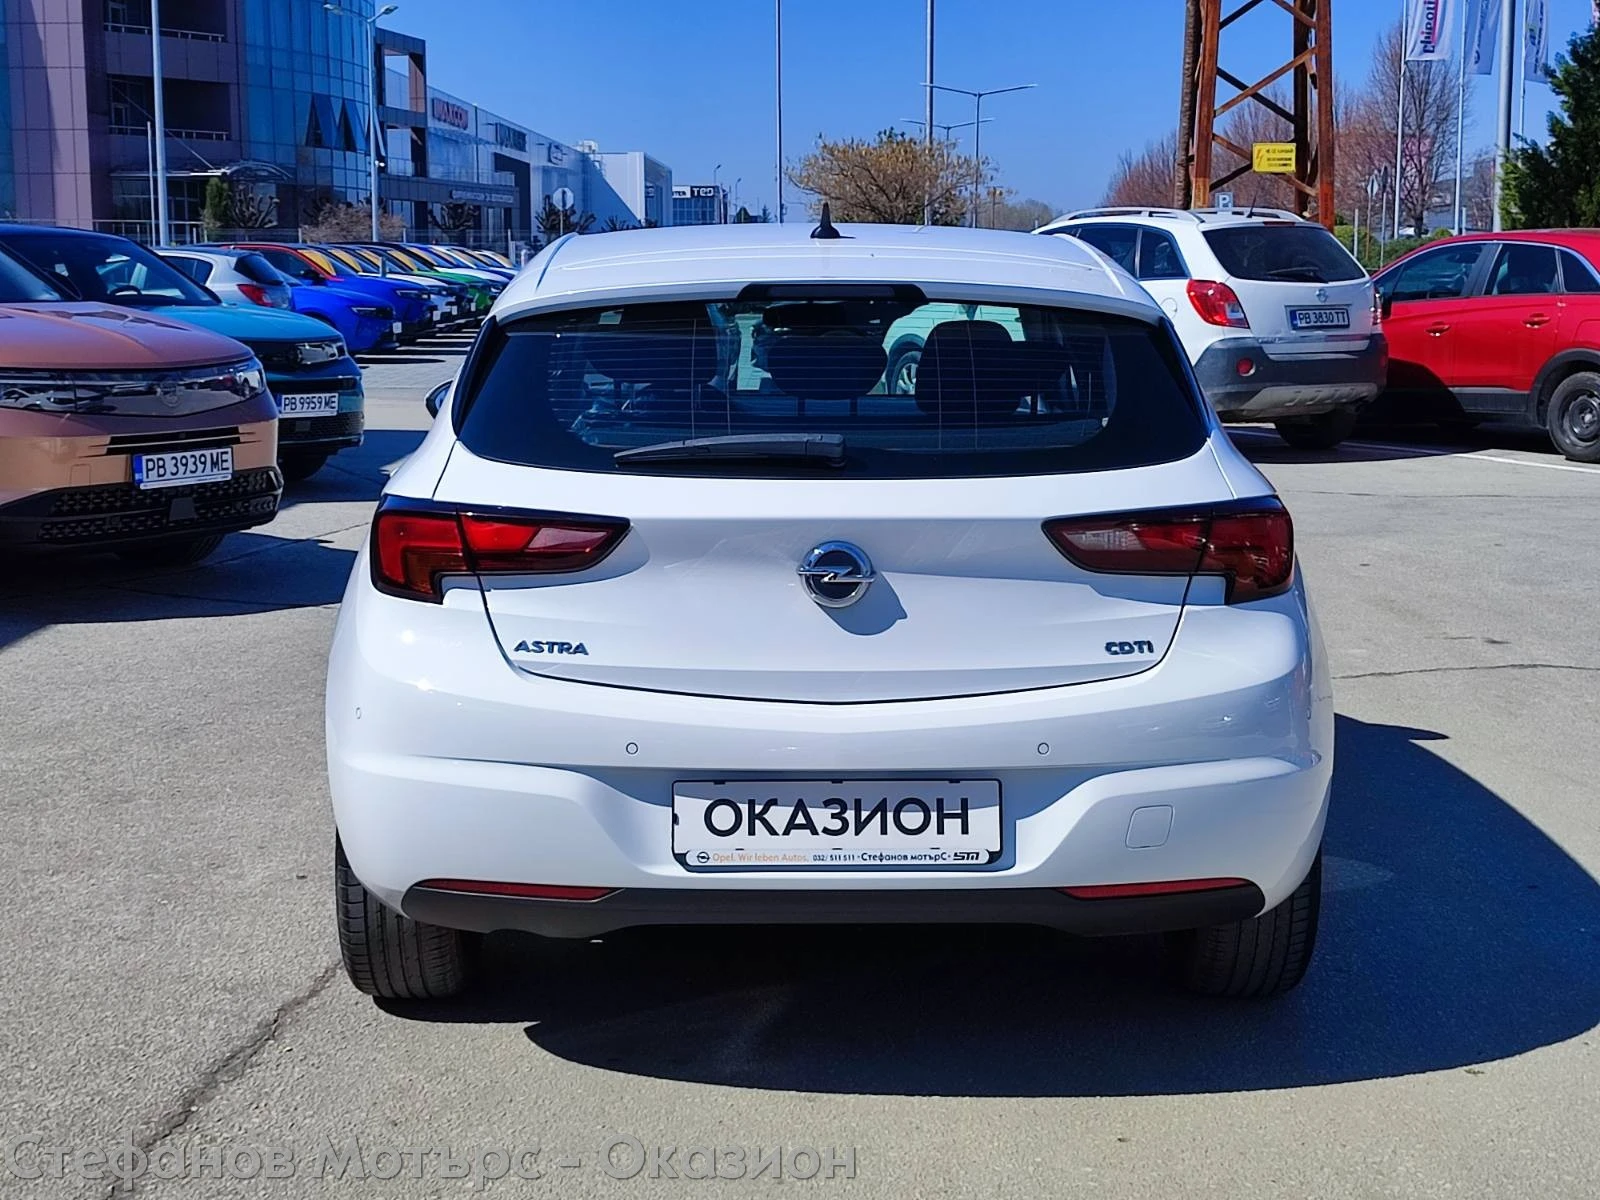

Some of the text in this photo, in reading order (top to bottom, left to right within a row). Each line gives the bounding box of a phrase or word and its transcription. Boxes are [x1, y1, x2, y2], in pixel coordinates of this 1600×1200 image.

[1312, 311, 1334, 324] 3830
[299, 395, 323, 410] 9959
[170, 453, 207, 477] 3939
[514, 639, 589, 656] ASTRA
[1105, 640, 1154, 655] CDTI
[703, 796, 970, 837] ОКАЗИОН
[738, 853, 753, 862] Wir
[755, 853, 779, 862] leben
[829, 854, 842, 862] 511
[843, 854, 855, 862] 511
